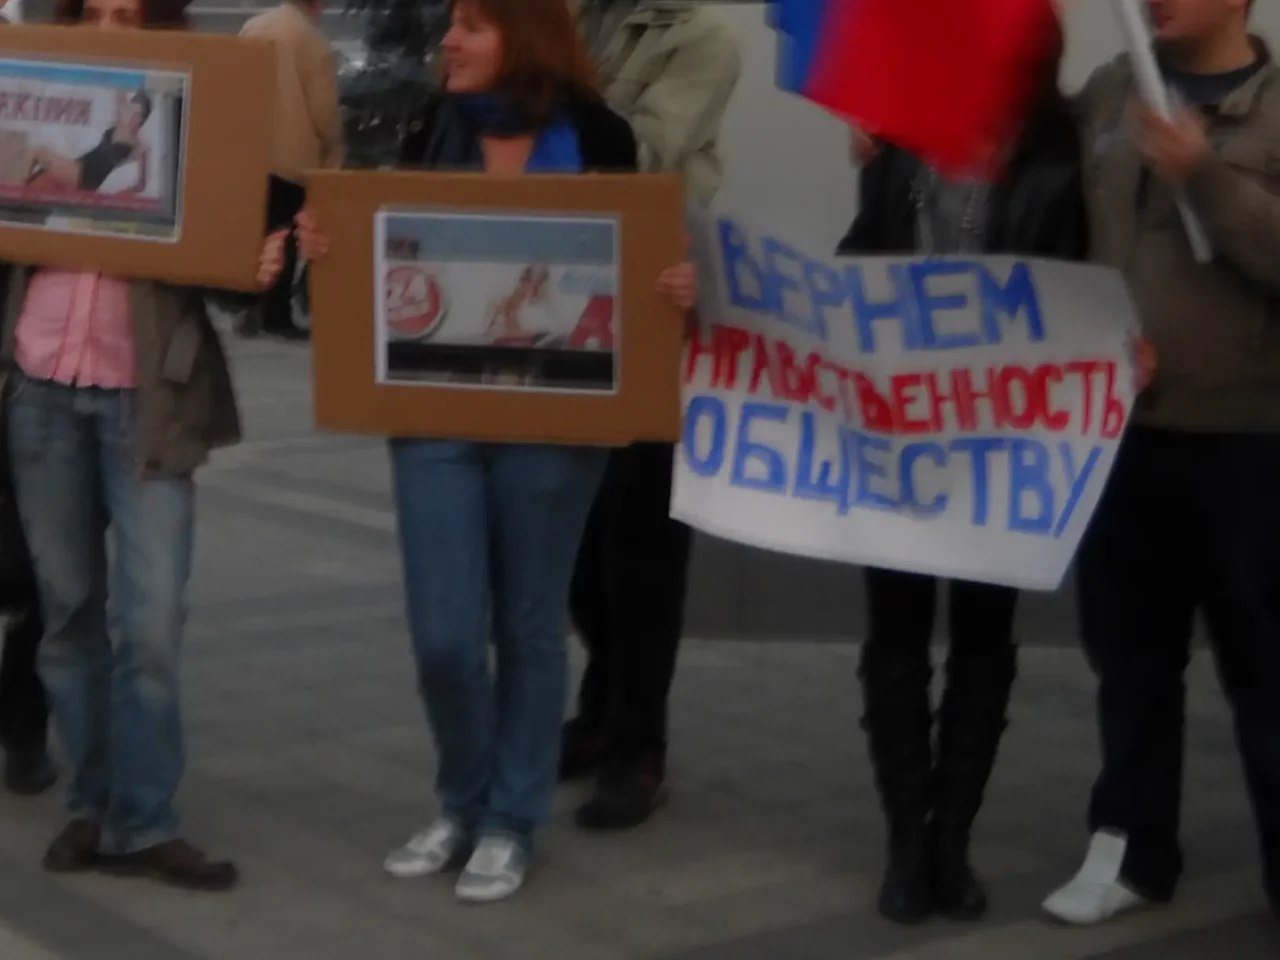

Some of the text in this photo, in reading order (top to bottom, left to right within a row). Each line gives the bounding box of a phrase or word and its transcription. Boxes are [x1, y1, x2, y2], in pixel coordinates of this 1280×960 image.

[717, 216, 1046, 353] ВЕРНЕМ
[685, 324, 1125, 439] НРАВСТВЕННОСТЬ
[682, 395, 1103, 538] ОБЩЕСТВУ
